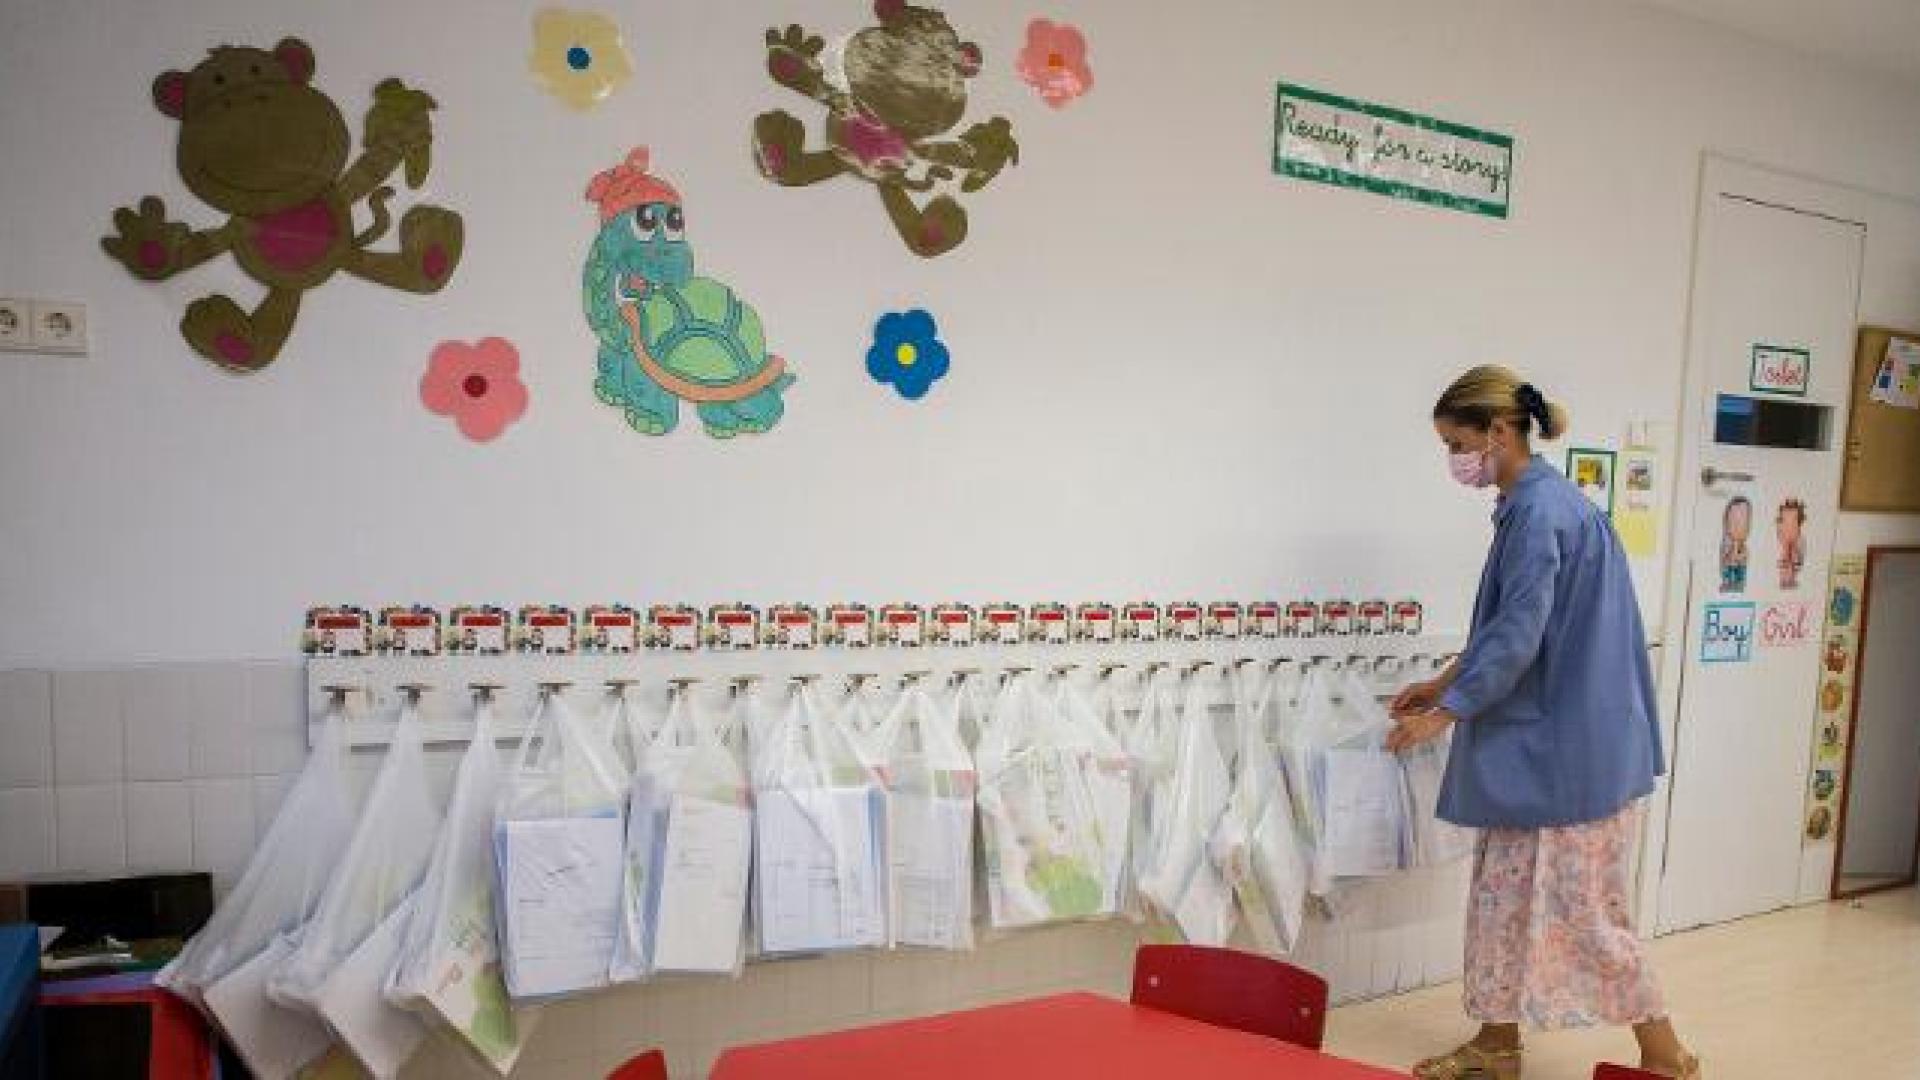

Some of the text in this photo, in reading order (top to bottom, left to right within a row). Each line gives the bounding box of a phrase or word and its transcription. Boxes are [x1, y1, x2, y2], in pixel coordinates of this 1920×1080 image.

[1281, 101, 1359, 162] Ready
[1373, 123, 1410, 161] for
[1415, 149, 1435, 166] a
[1704, 609, 1749, 660] Boy
[1763, 605, 1808, 641] Girl
